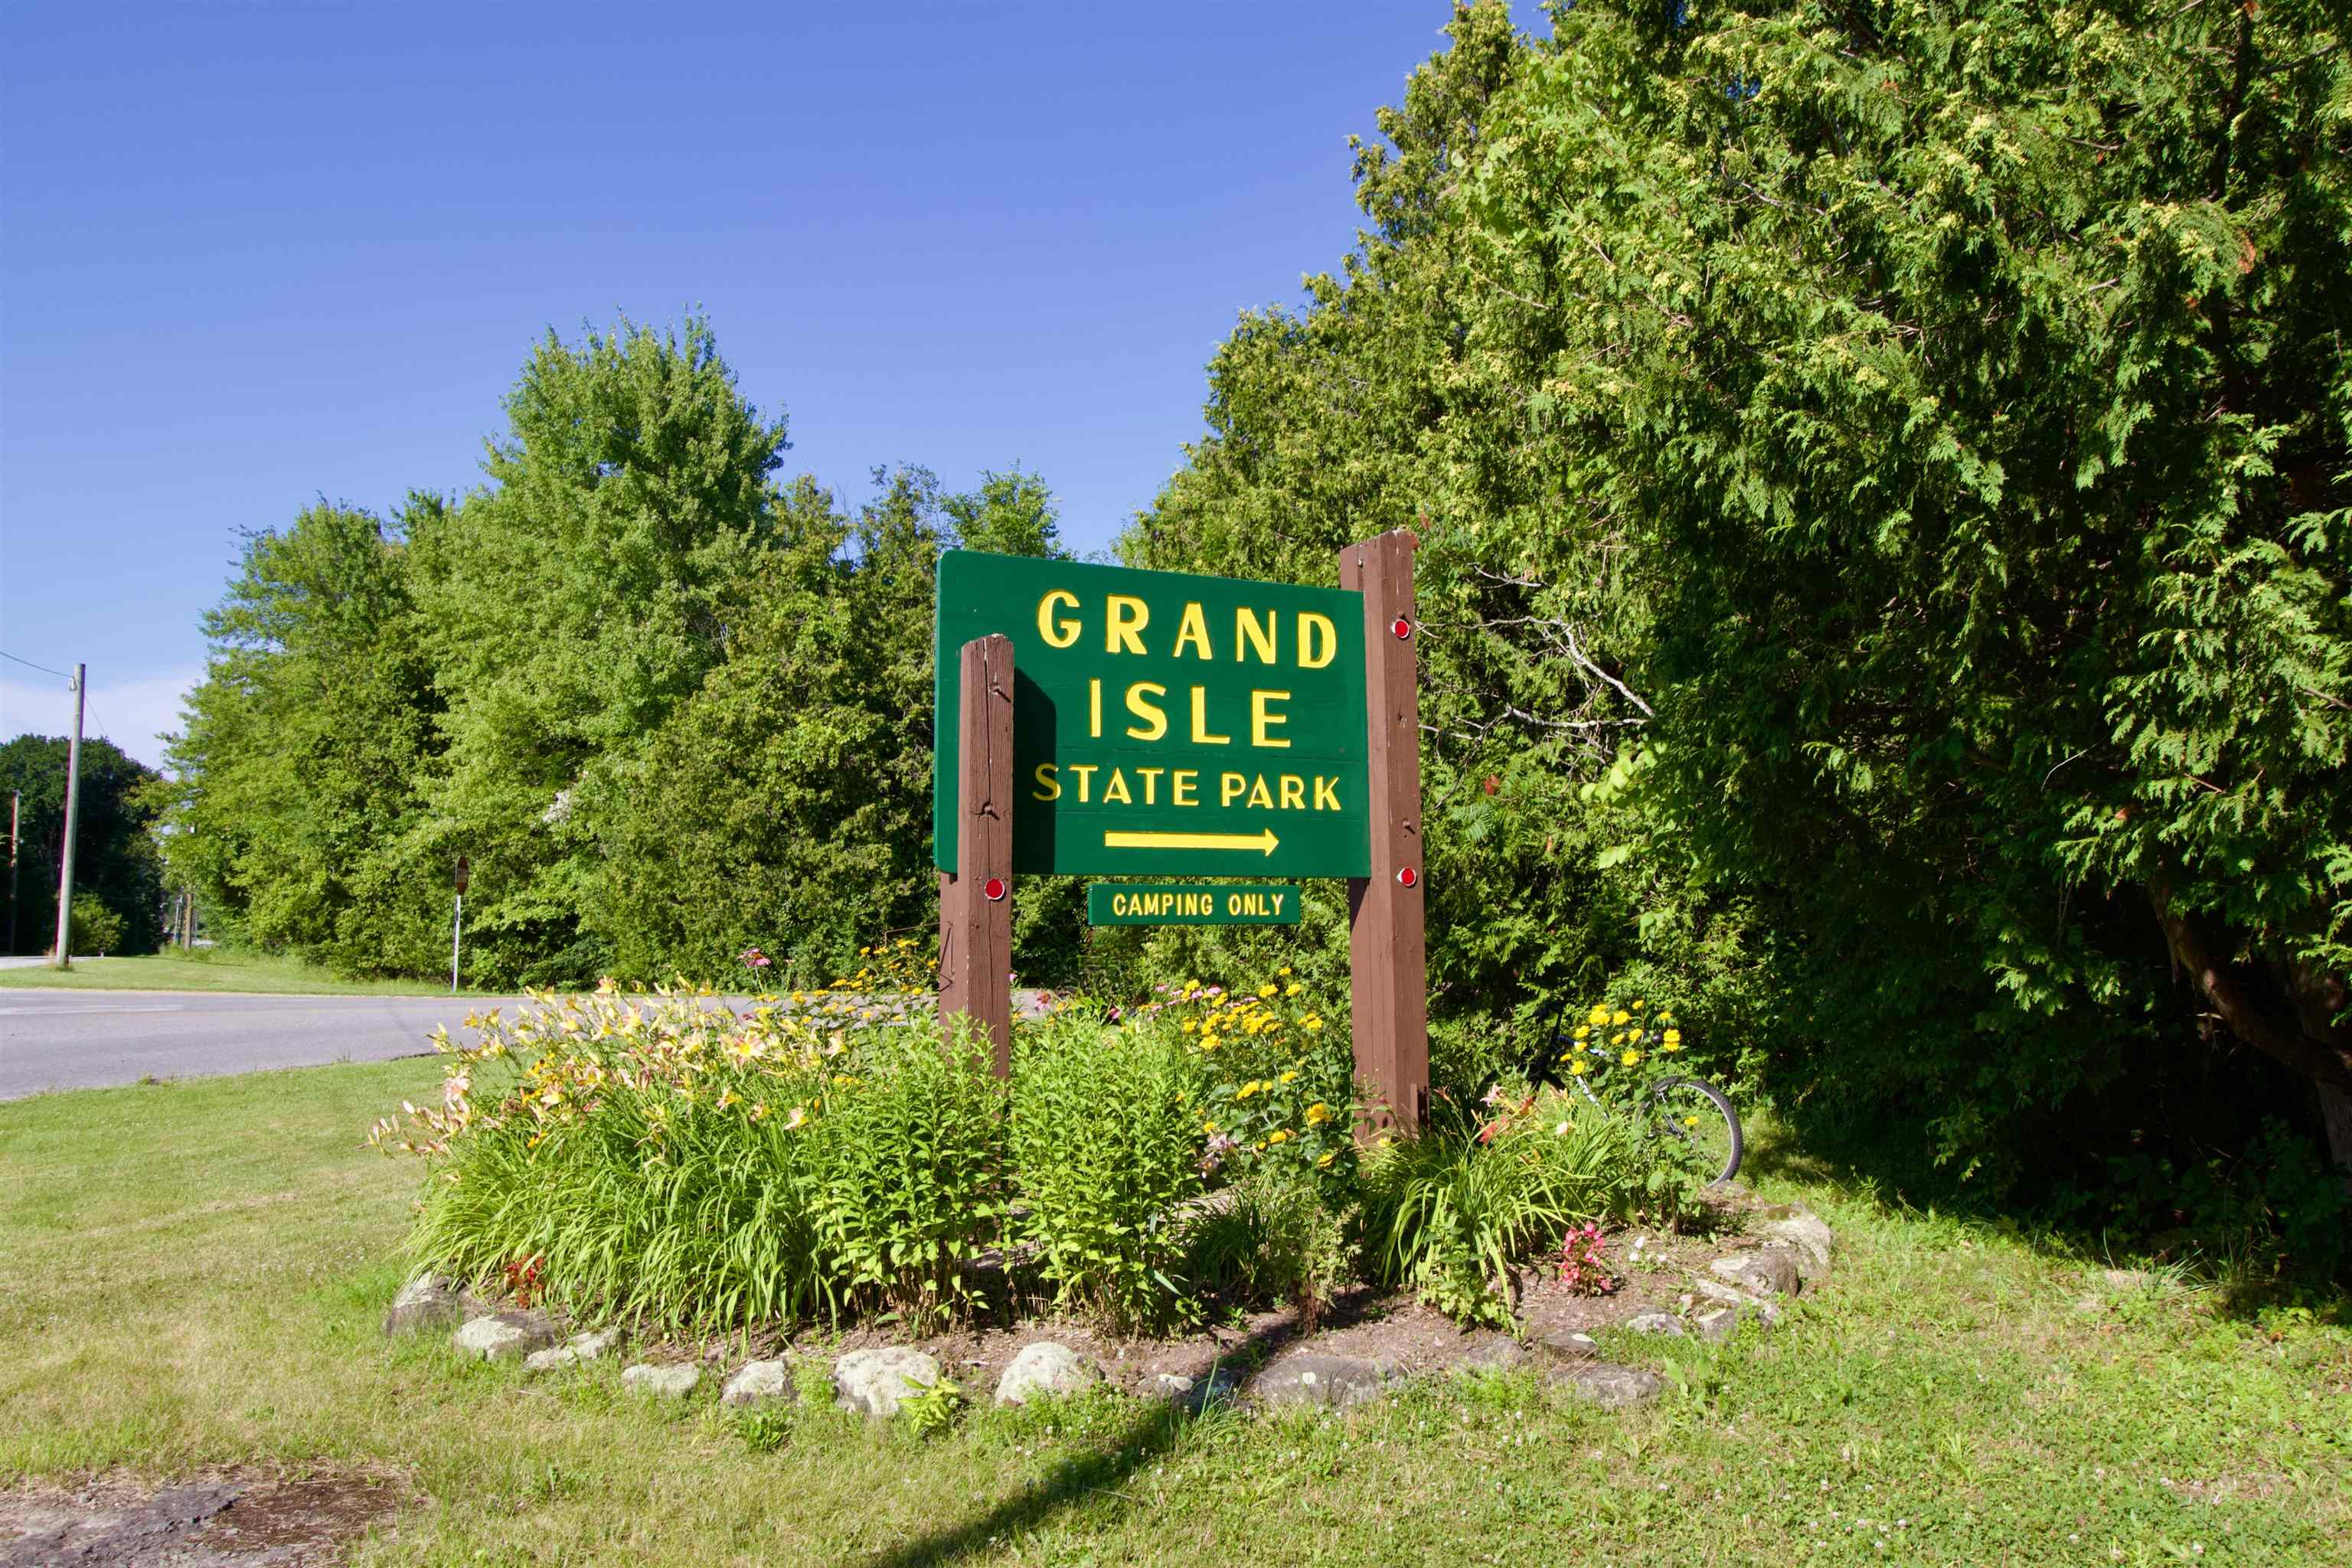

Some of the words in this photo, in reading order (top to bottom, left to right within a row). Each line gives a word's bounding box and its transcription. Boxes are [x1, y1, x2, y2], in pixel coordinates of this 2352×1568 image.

[1037, 590, 1338, 668] GRAND
[1089, 679, 1292, 748] ISLE
[1033, 763, 1200, 807] STATE
[1220, 773, 1342, 811] PARK
[1112, 893, 1214, 917] CAMPING
[1228, 893, 1285, 916] ONLY
